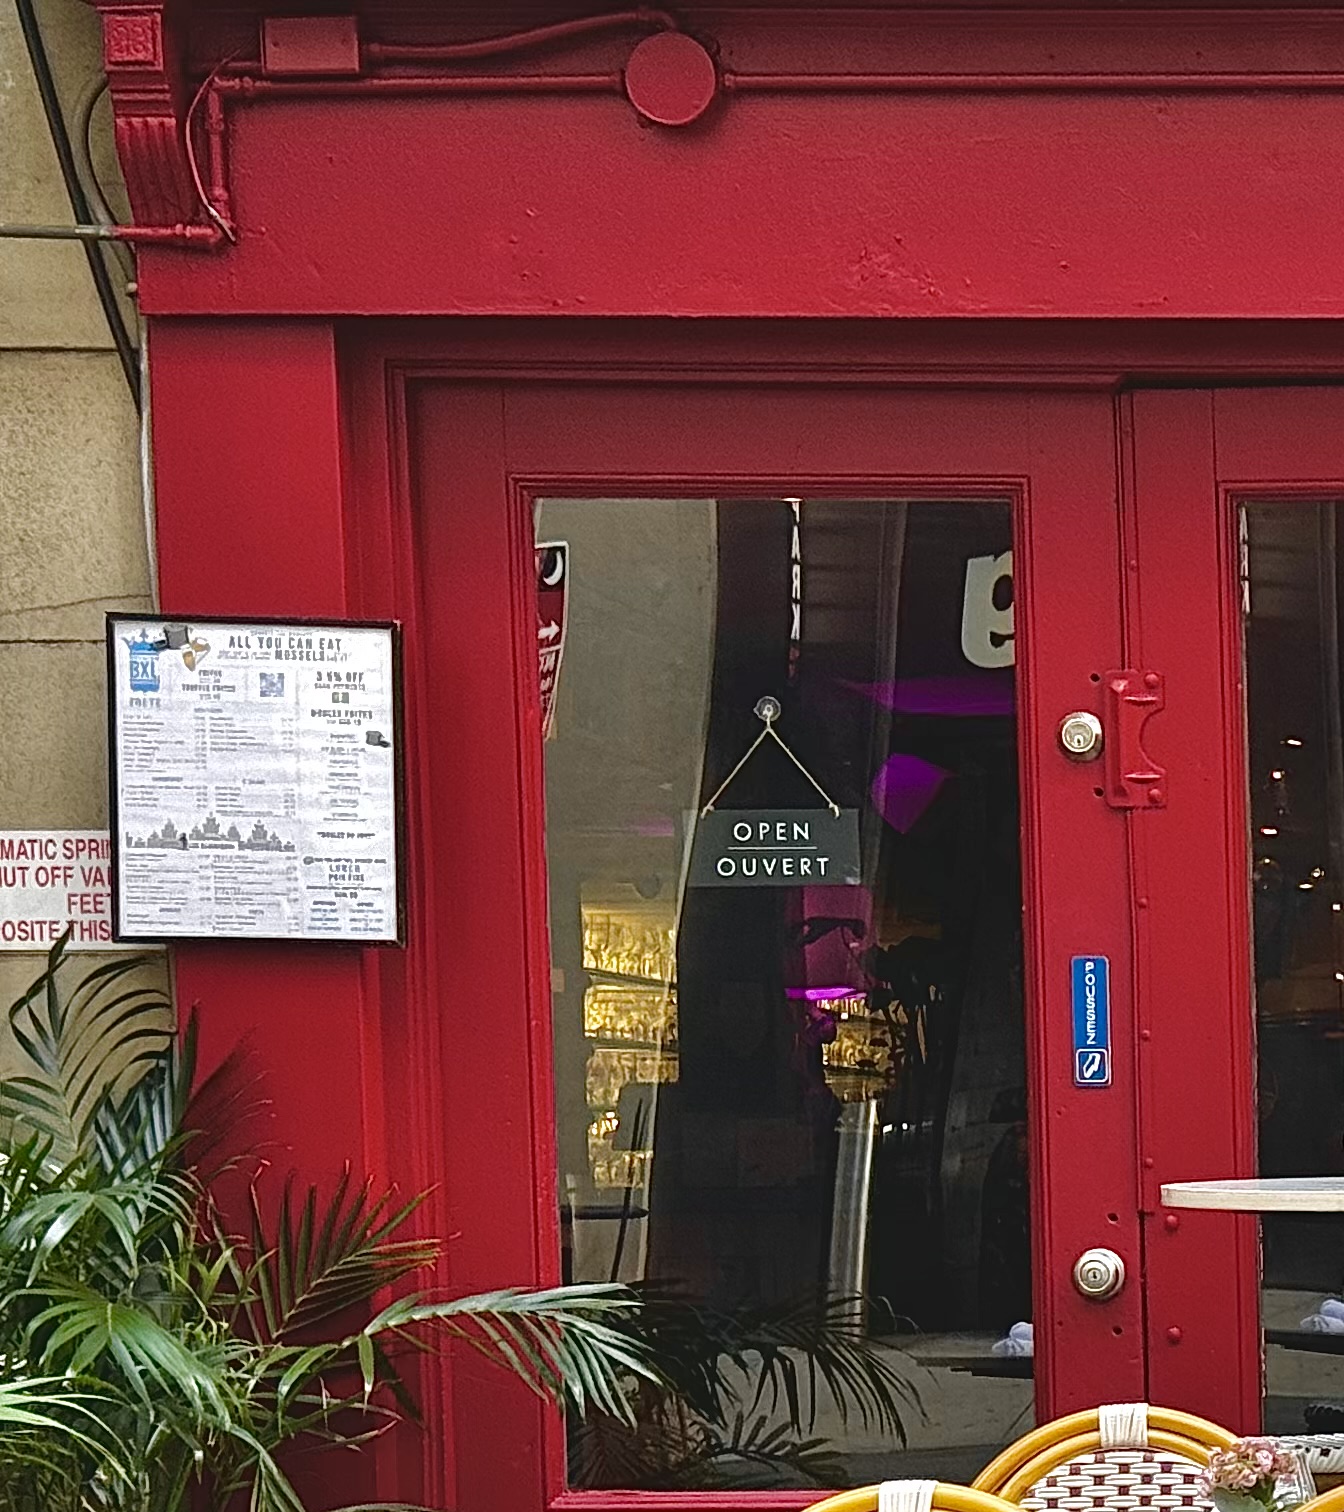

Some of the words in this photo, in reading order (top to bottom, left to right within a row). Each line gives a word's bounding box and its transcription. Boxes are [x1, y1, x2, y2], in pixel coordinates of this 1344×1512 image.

[229, 635, 251, 649] ALL
[257, 636, 281, 649] YOU
[289, 637, 312, 649] CAN
[319, 637, 342, 651] EAT
[130, 661, 157, 679] BXL
[733, 822, 810, 841] OPEN
[0, 865, 30, 888] UT
[35, 865, 75, 888] OFF
[716, 857, 830, 877] OUVERT
[2, 919, 61, 942] OSITE
[66, 919, 111, 942] THIS
[1085, 961, 1097, 1045] POUSSEZ
